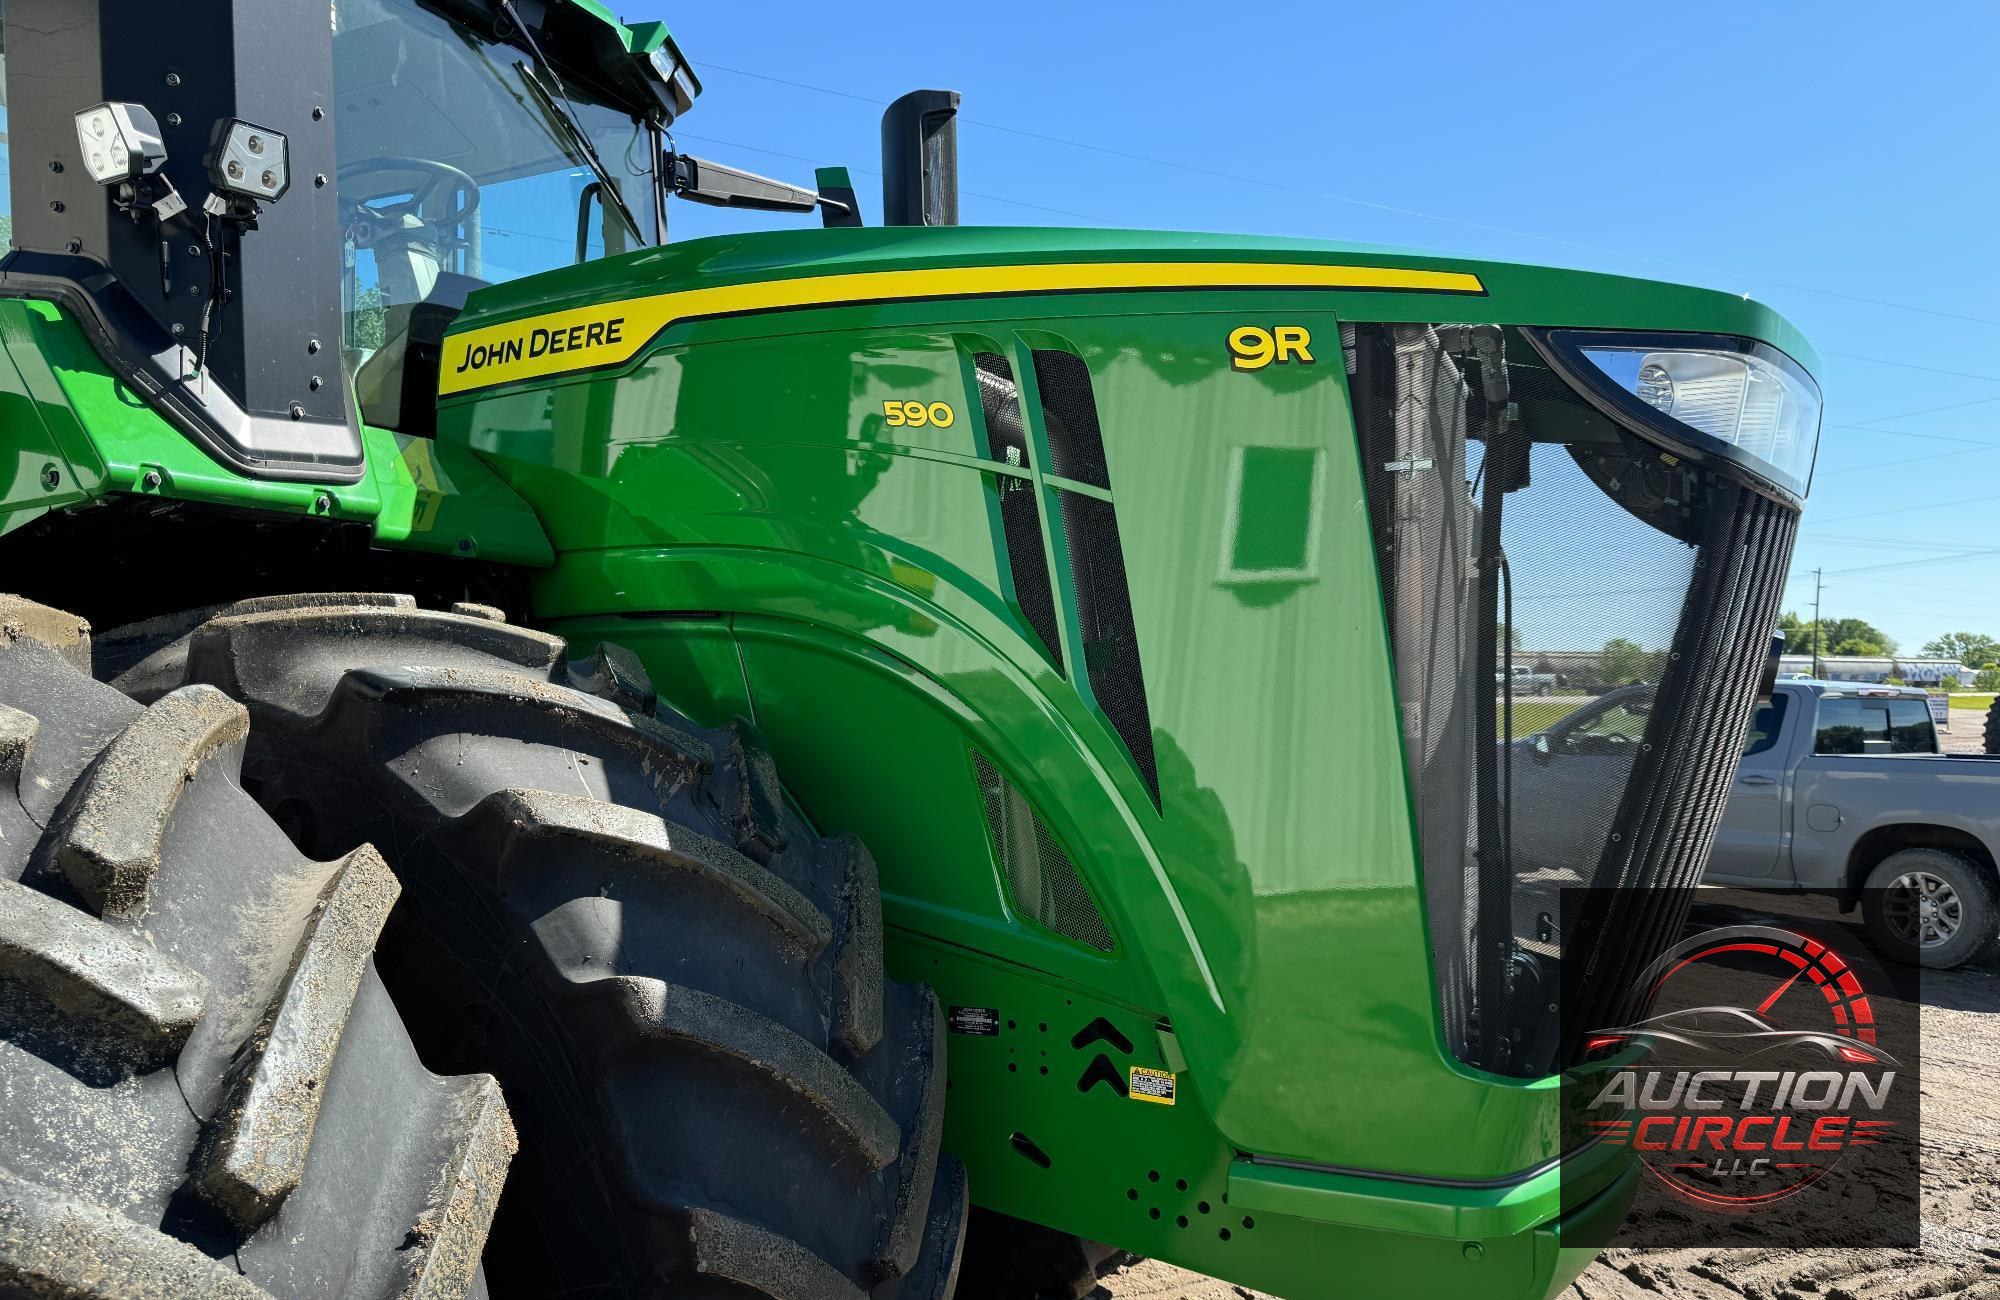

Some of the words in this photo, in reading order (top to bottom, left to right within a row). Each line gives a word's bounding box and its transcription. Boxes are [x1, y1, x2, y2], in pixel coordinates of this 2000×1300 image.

[456, 338, 524, 374] JOHN
[529, 318, 625, 358] DEERE
[1225, 325, 1316, 373] 9R
[882, 400, 955, 429] 590
